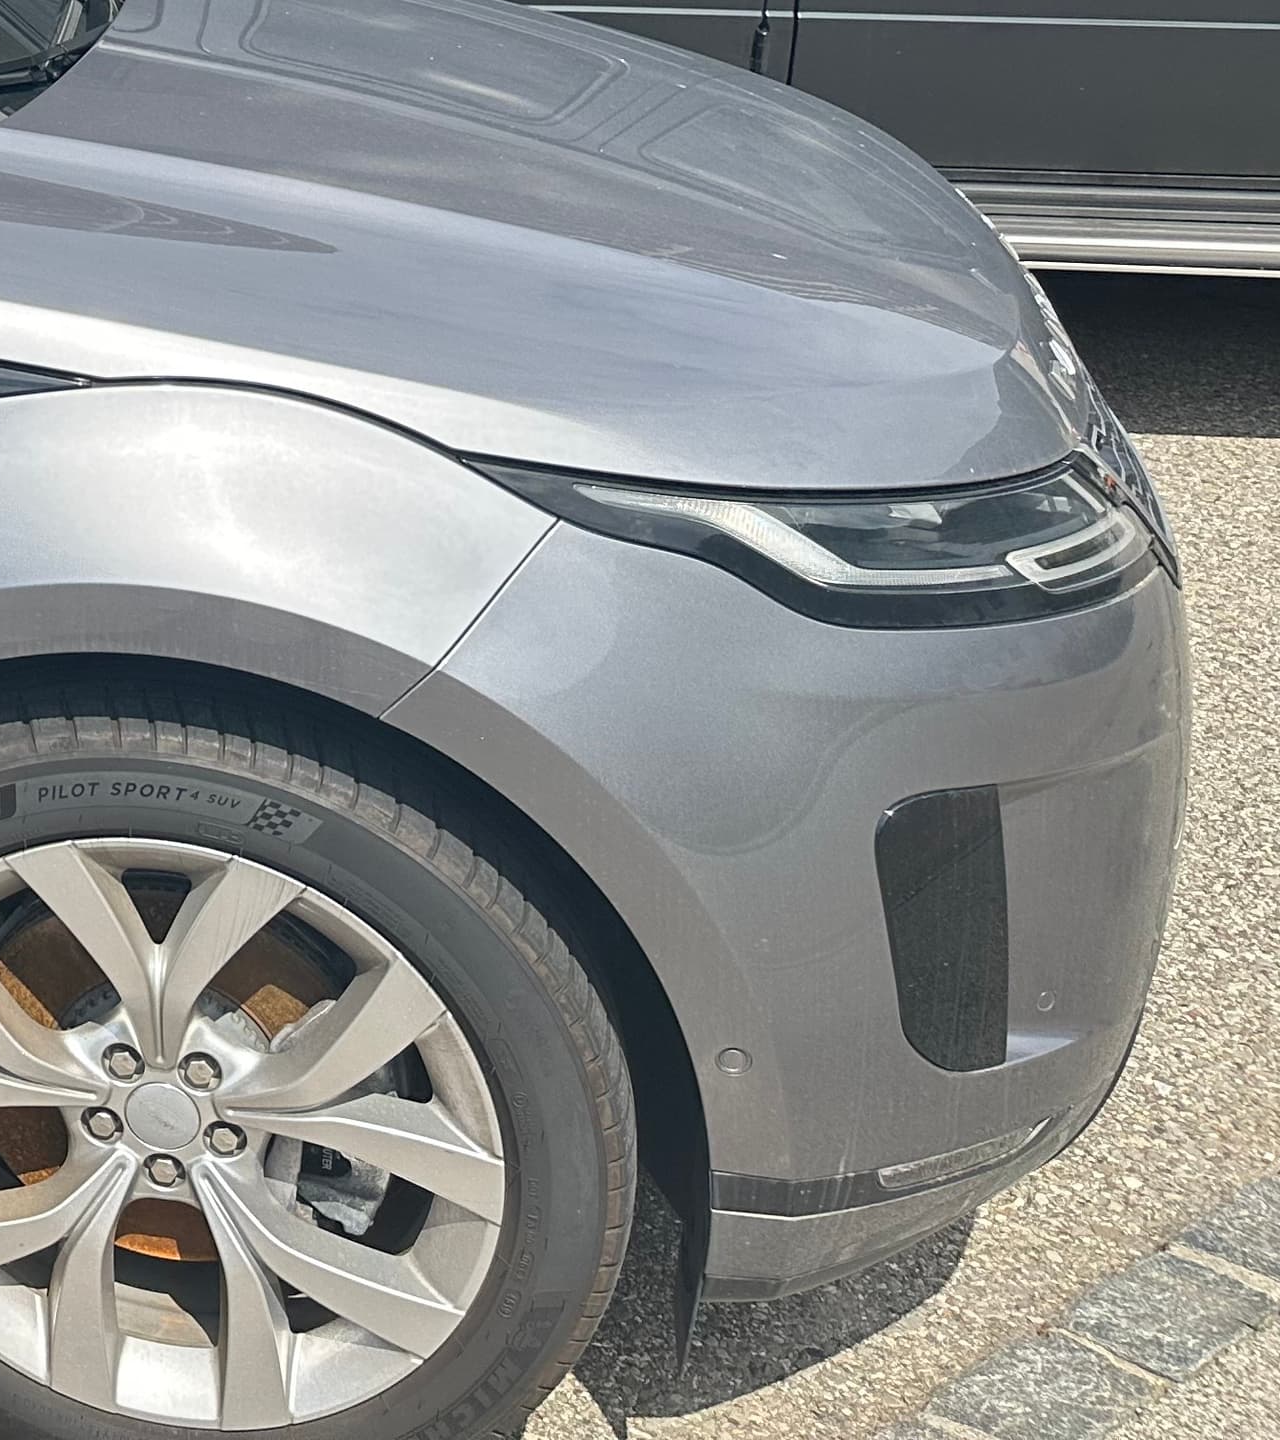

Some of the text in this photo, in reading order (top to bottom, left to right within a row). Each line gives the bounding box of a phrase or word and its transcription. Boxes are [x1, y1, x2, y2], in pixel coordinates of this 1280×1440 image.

[38, 782, 241, 809] PILOT SPORT 4 SUV
[321, 1148, 333, 1170] UTER
